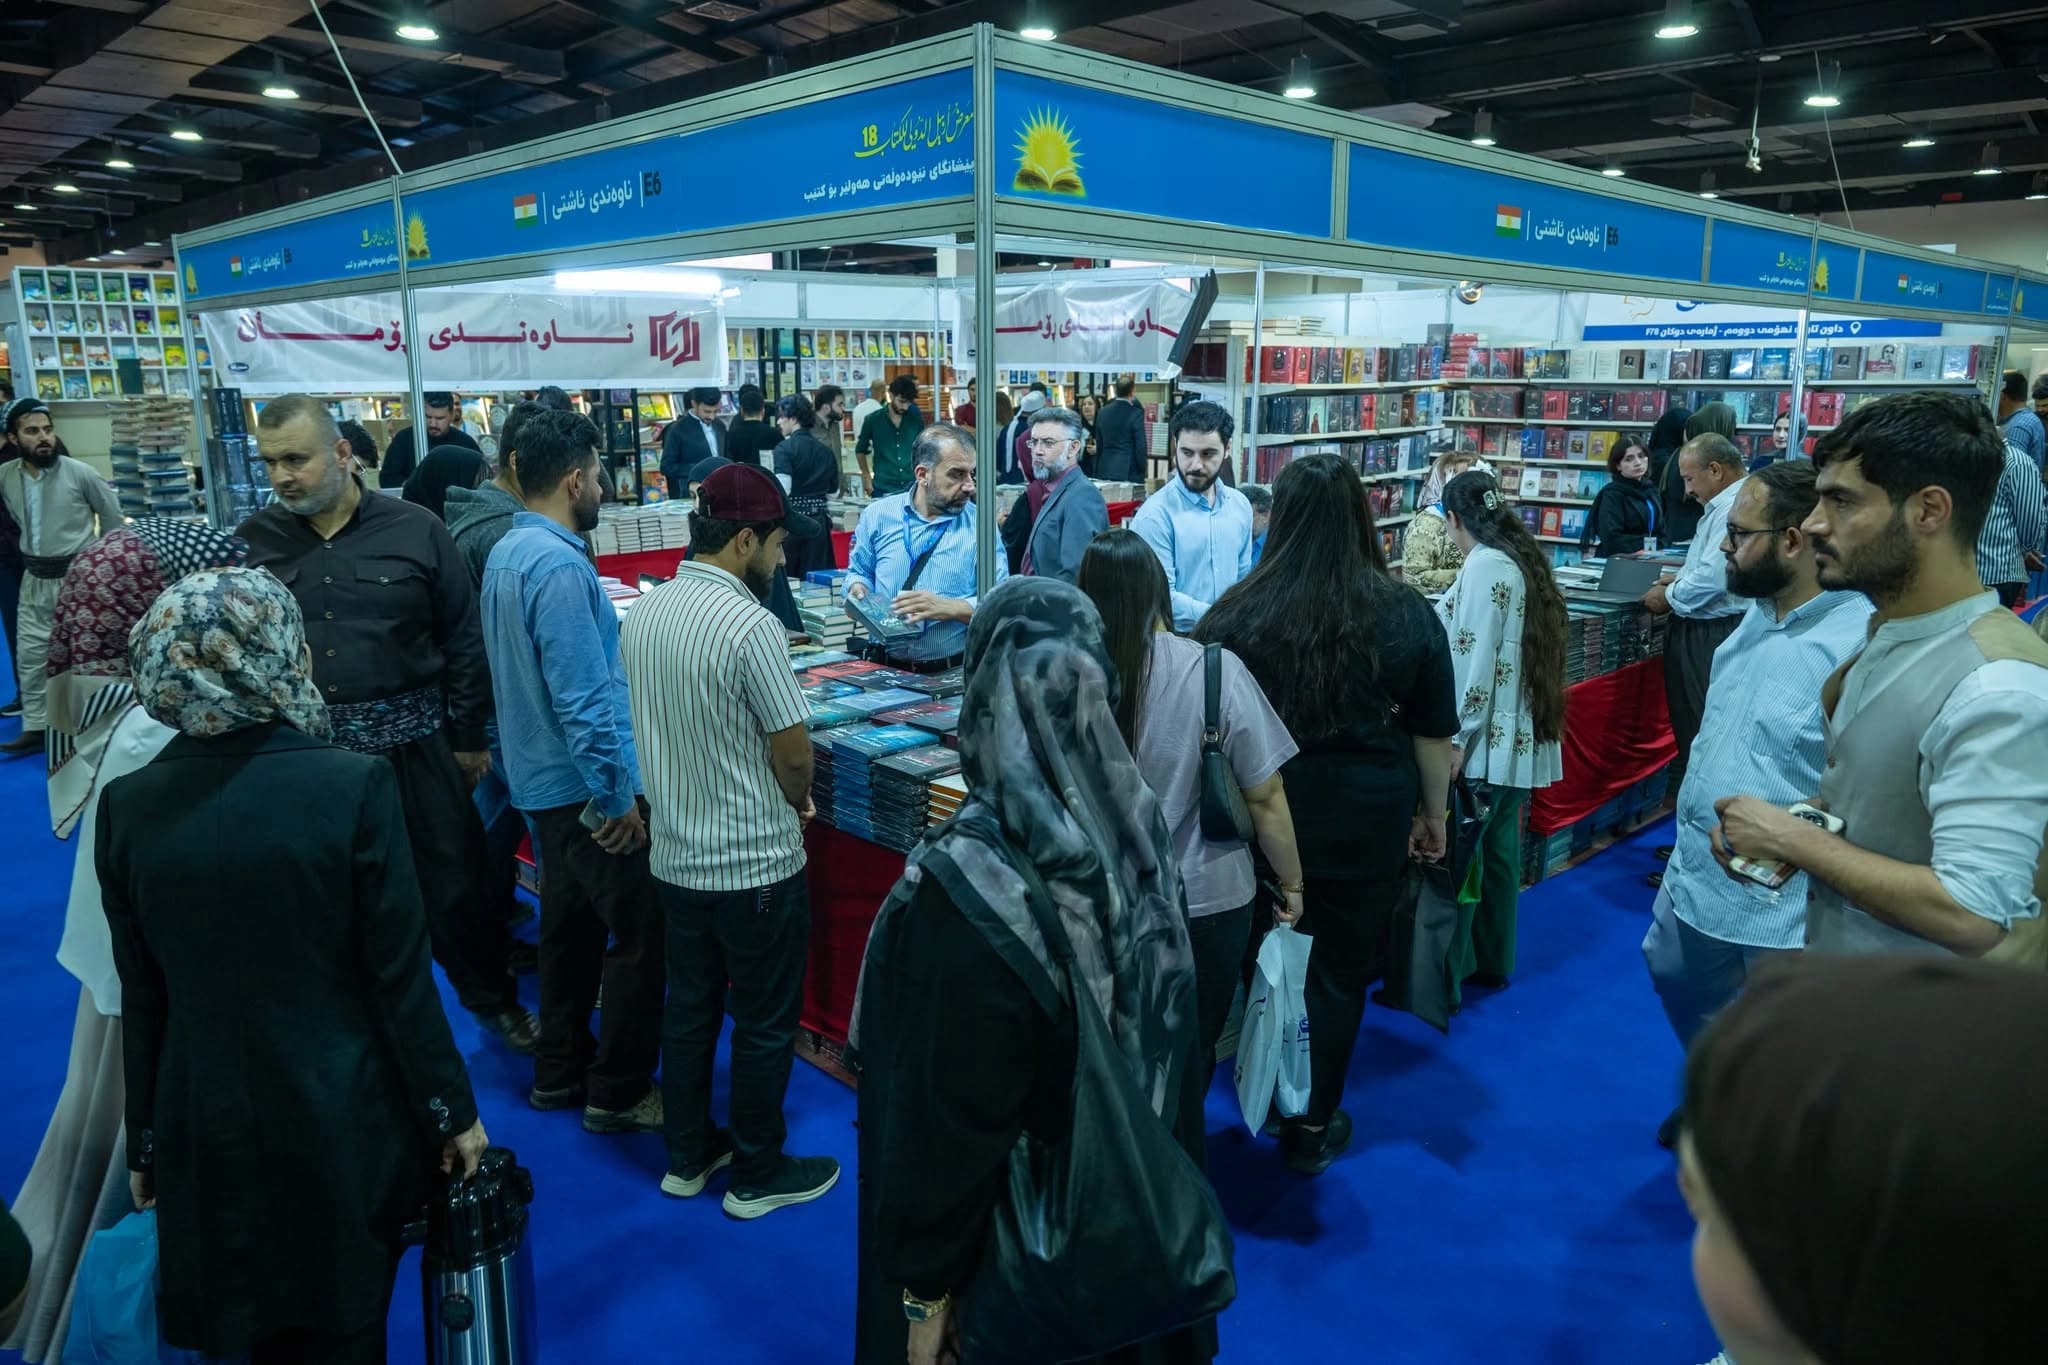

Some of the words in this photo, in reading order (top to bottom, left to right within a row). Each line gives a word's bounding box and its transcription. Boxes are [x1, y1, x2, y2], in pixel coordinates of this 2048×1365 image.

[862, 124, 878, 147] 18
[643, 170, 661, 197] E6
[552, 189, 585, 220] ئاشتی
[590, 180, 632, 213] ناوەندی
[1535, 217, 1565, 240] ئاشتی
[1567, 224, 1600, 247] ناوەندی
[1607, 227, 1618, 246] E6
[428, 319, 634, 351] ناوەندی
